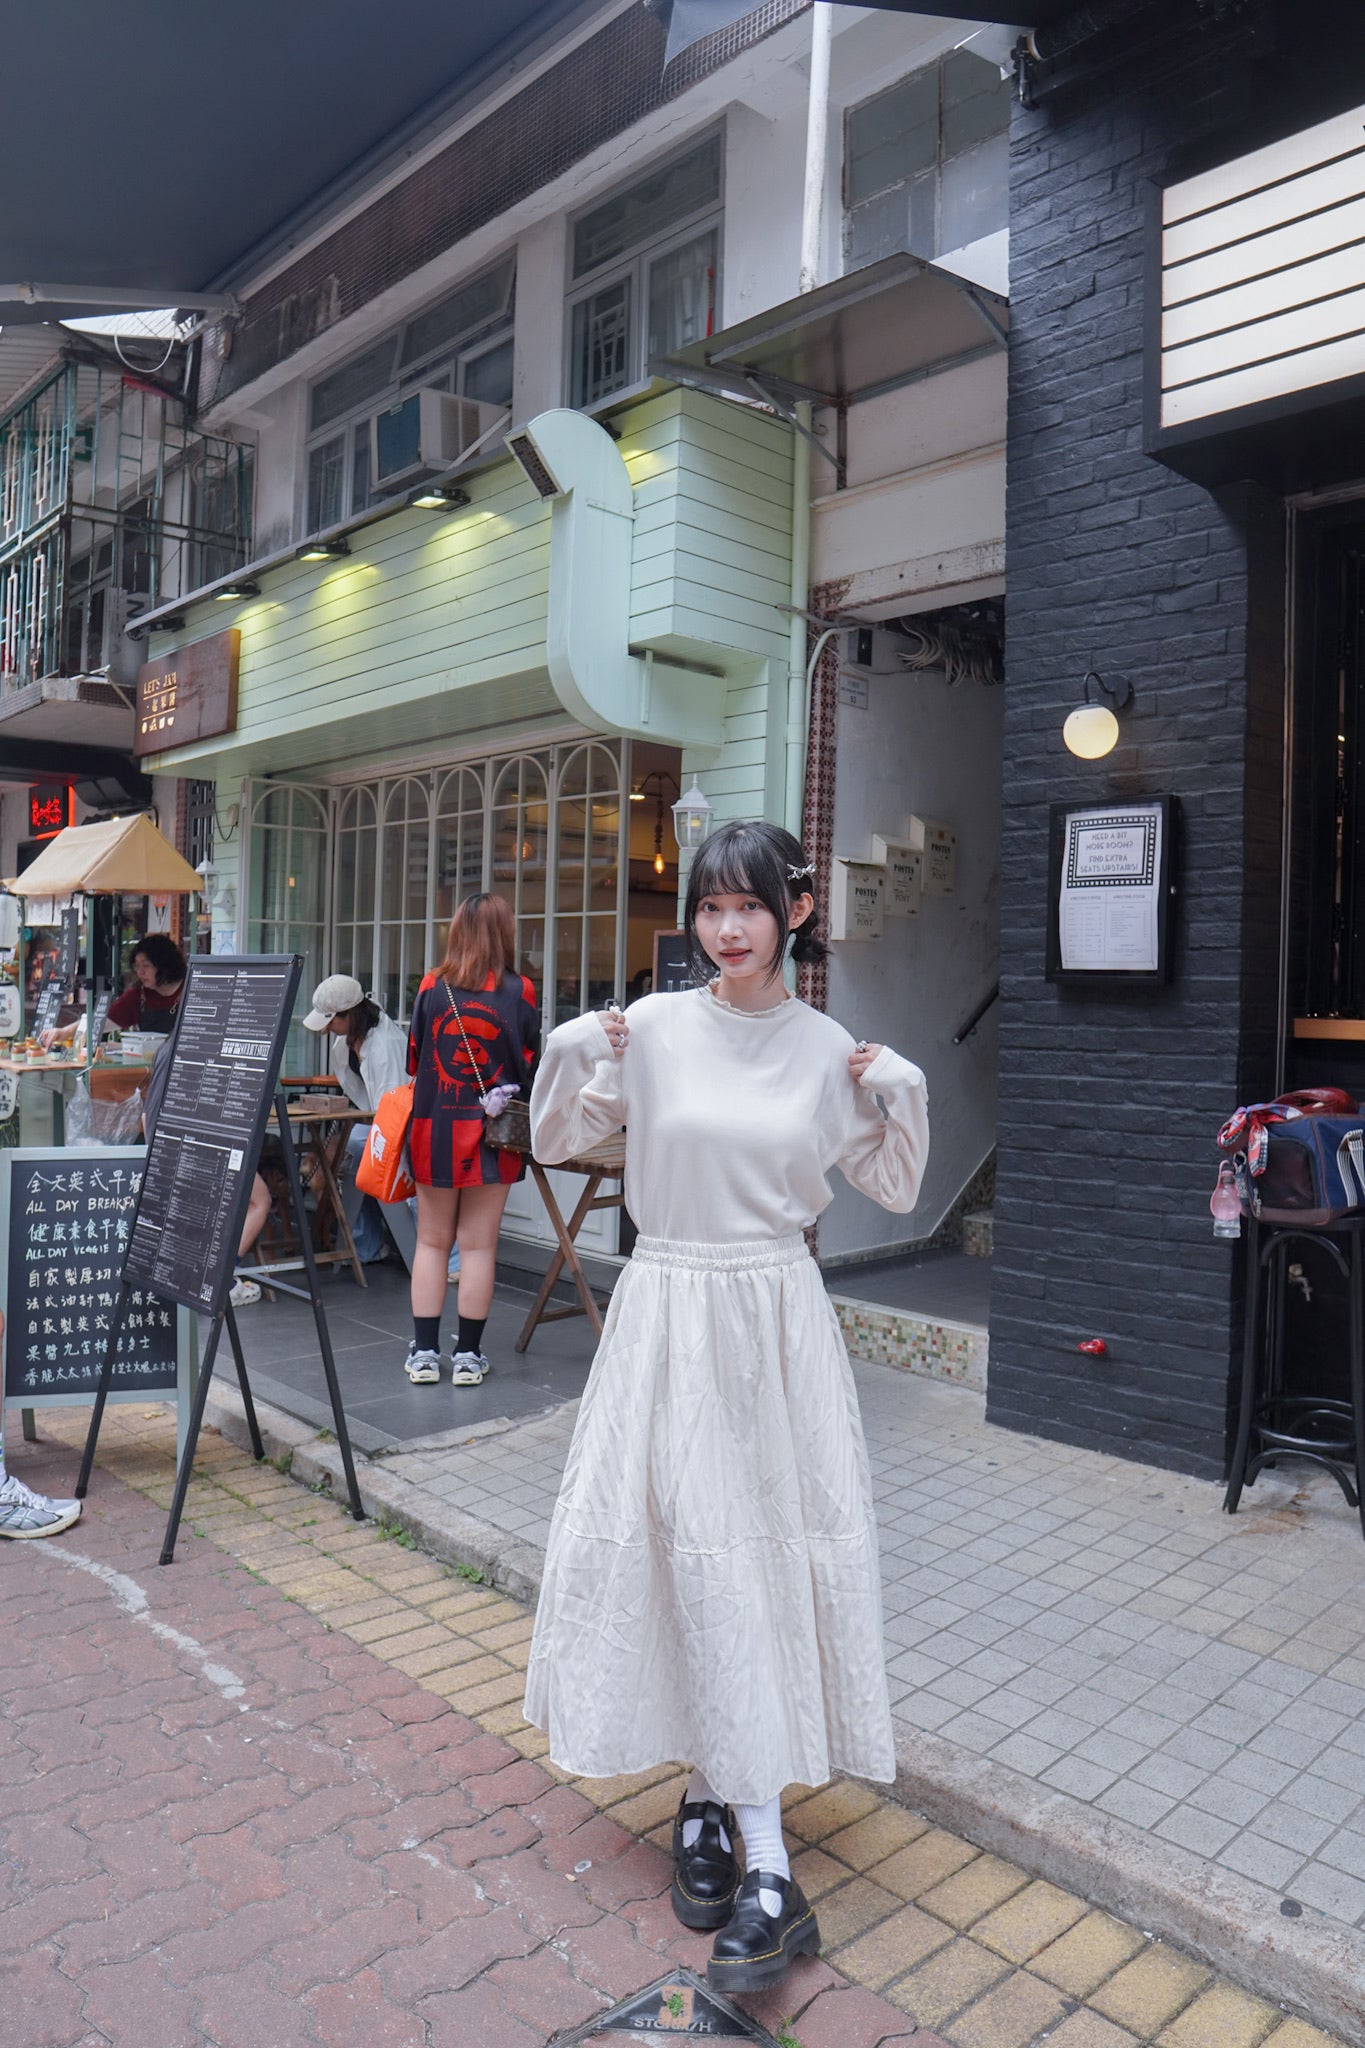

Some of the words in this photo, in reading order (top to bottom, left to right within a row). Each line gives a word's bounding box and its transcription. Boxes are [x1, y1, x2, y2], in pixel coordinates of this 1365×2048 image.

[1091, 832, 1109, 841] NEED
[1110, 832, 1116, 840] A
[1116, 831, 1128, 840] BIT
[1085, 842, 1105, 850] MORE
[1106, 840, 1134, 849] ROOM?
[1089, 855, 1104, 863] FIND
[1105, 854, 1128, 862] EXTRA
[1080, 864, 1100, 873] SEATS
[1102, 863, 1138, 872] UPSTAIRS!
[855, 887, 878, 898] POSTES
[26, 1200, 47, 1215] ALL
[55, 1199, 80, 1213] DAY
[87, 1195, 136, 1212] BREAKFA
[28, 1218, 129, 1243] 健康素食早餐
[25, 1248, 46, 1261] ALL
[47, 1247, 68, 1258] DAY
[117, 1246, 128, 1254] B
